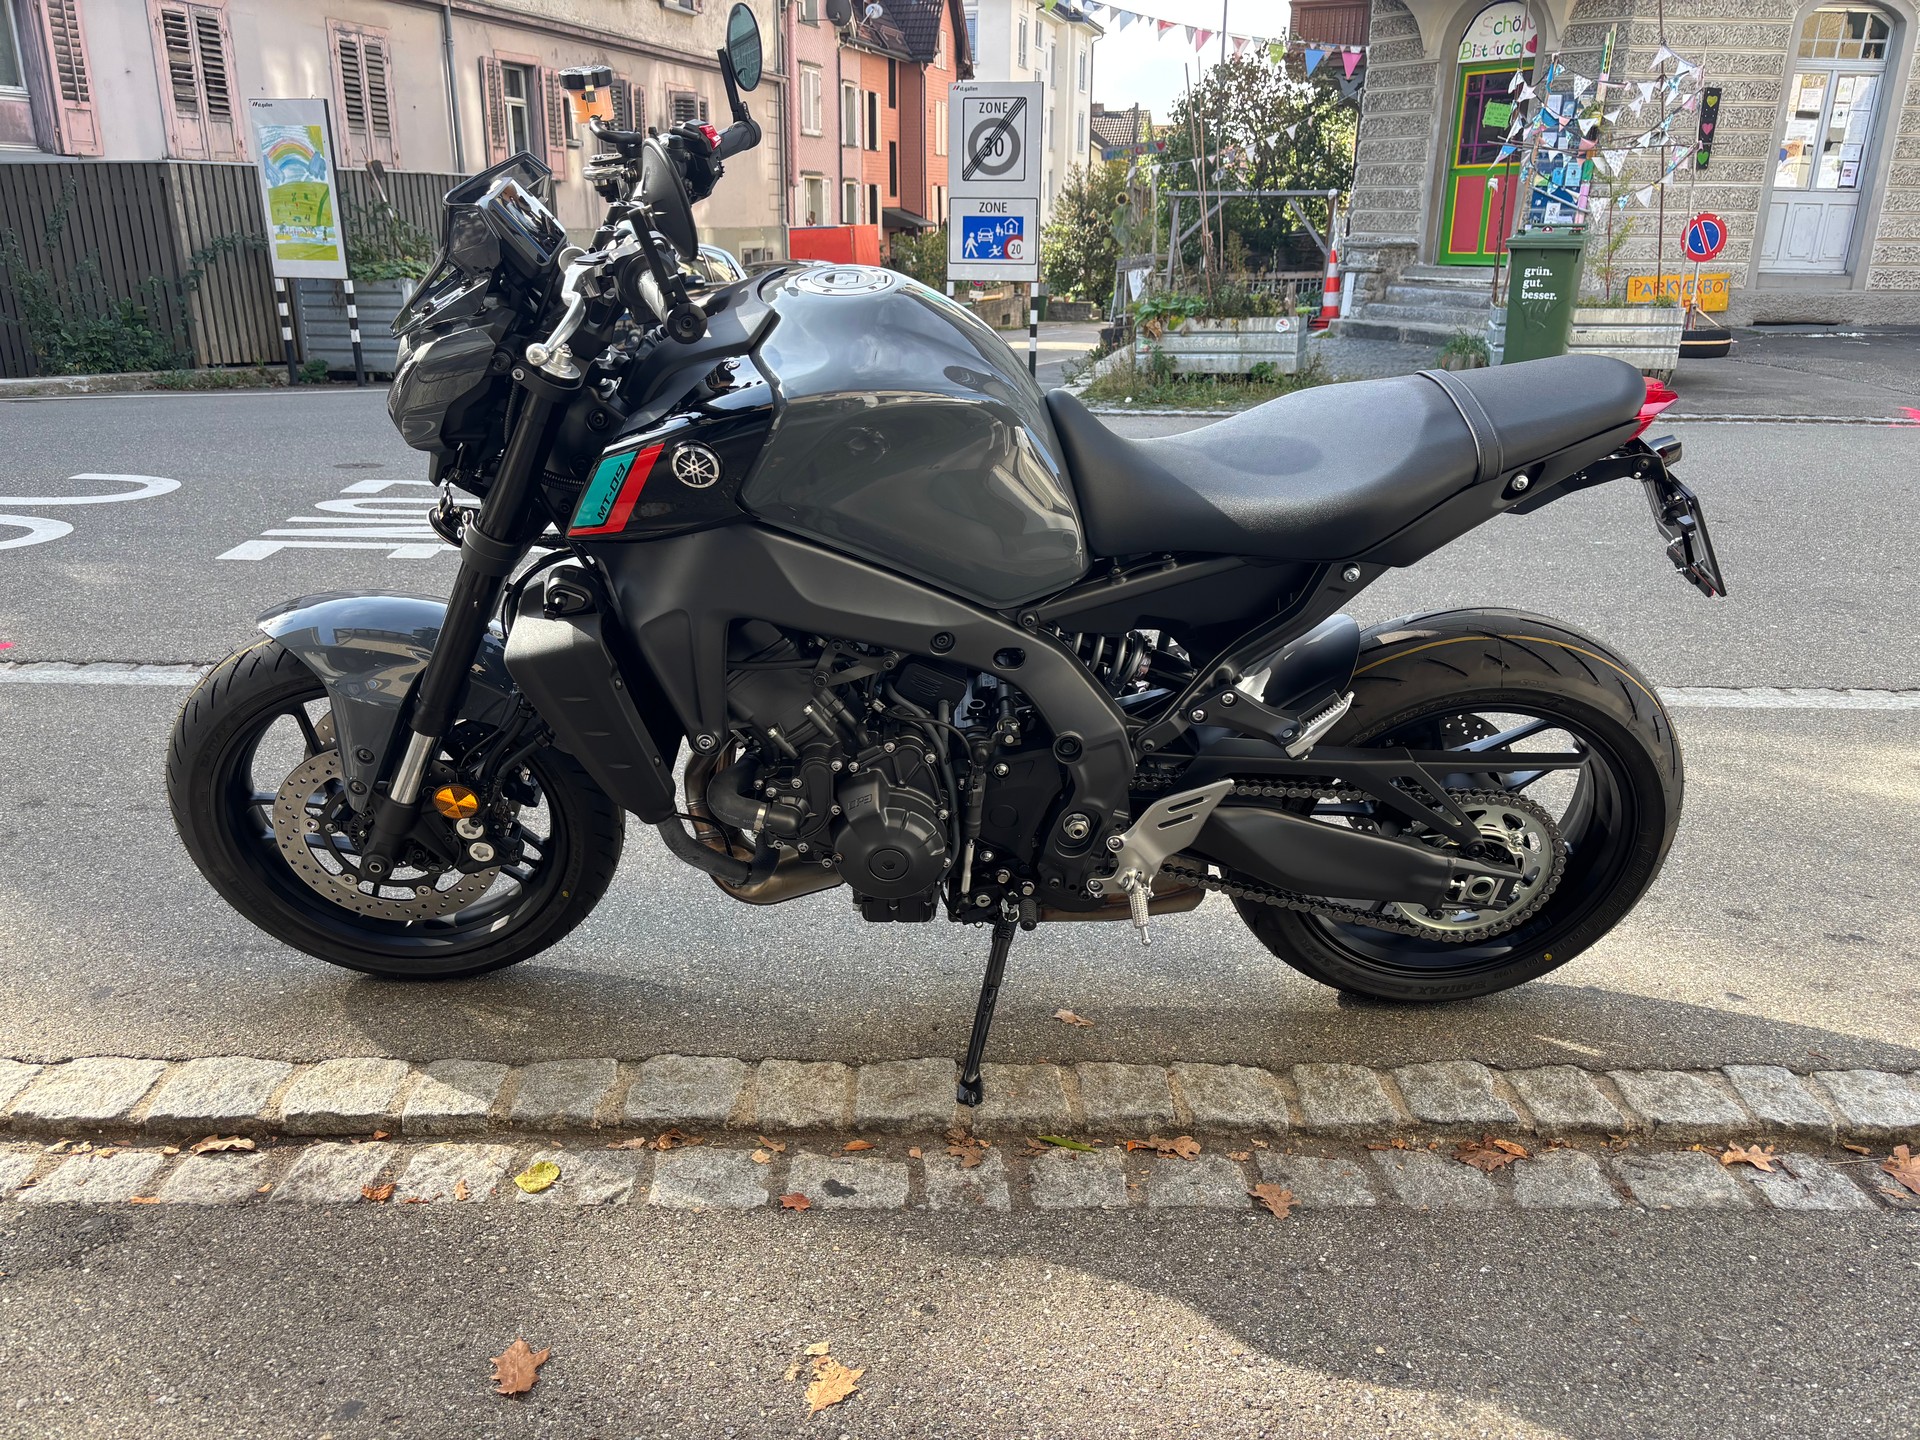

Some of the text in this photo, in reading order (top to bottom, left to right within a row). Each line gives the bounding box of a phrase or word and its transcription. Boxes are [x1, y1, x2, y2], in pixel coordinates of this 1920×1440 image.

[1479, 15, 1535, 36] Schön
[979, 101, 1008, 114] ZONE
[983, 137, 1004, 157] 30
[979, 201, 1007, 213] ZONE
[1011, 243, 1021, 255] 20
[1523, 266, 1553, 277] grün.
[1522, 279, 1543, 289] gut.
[1521, 289, 1557, 300] besser.
[597, 462, 627, 520] MT-09
